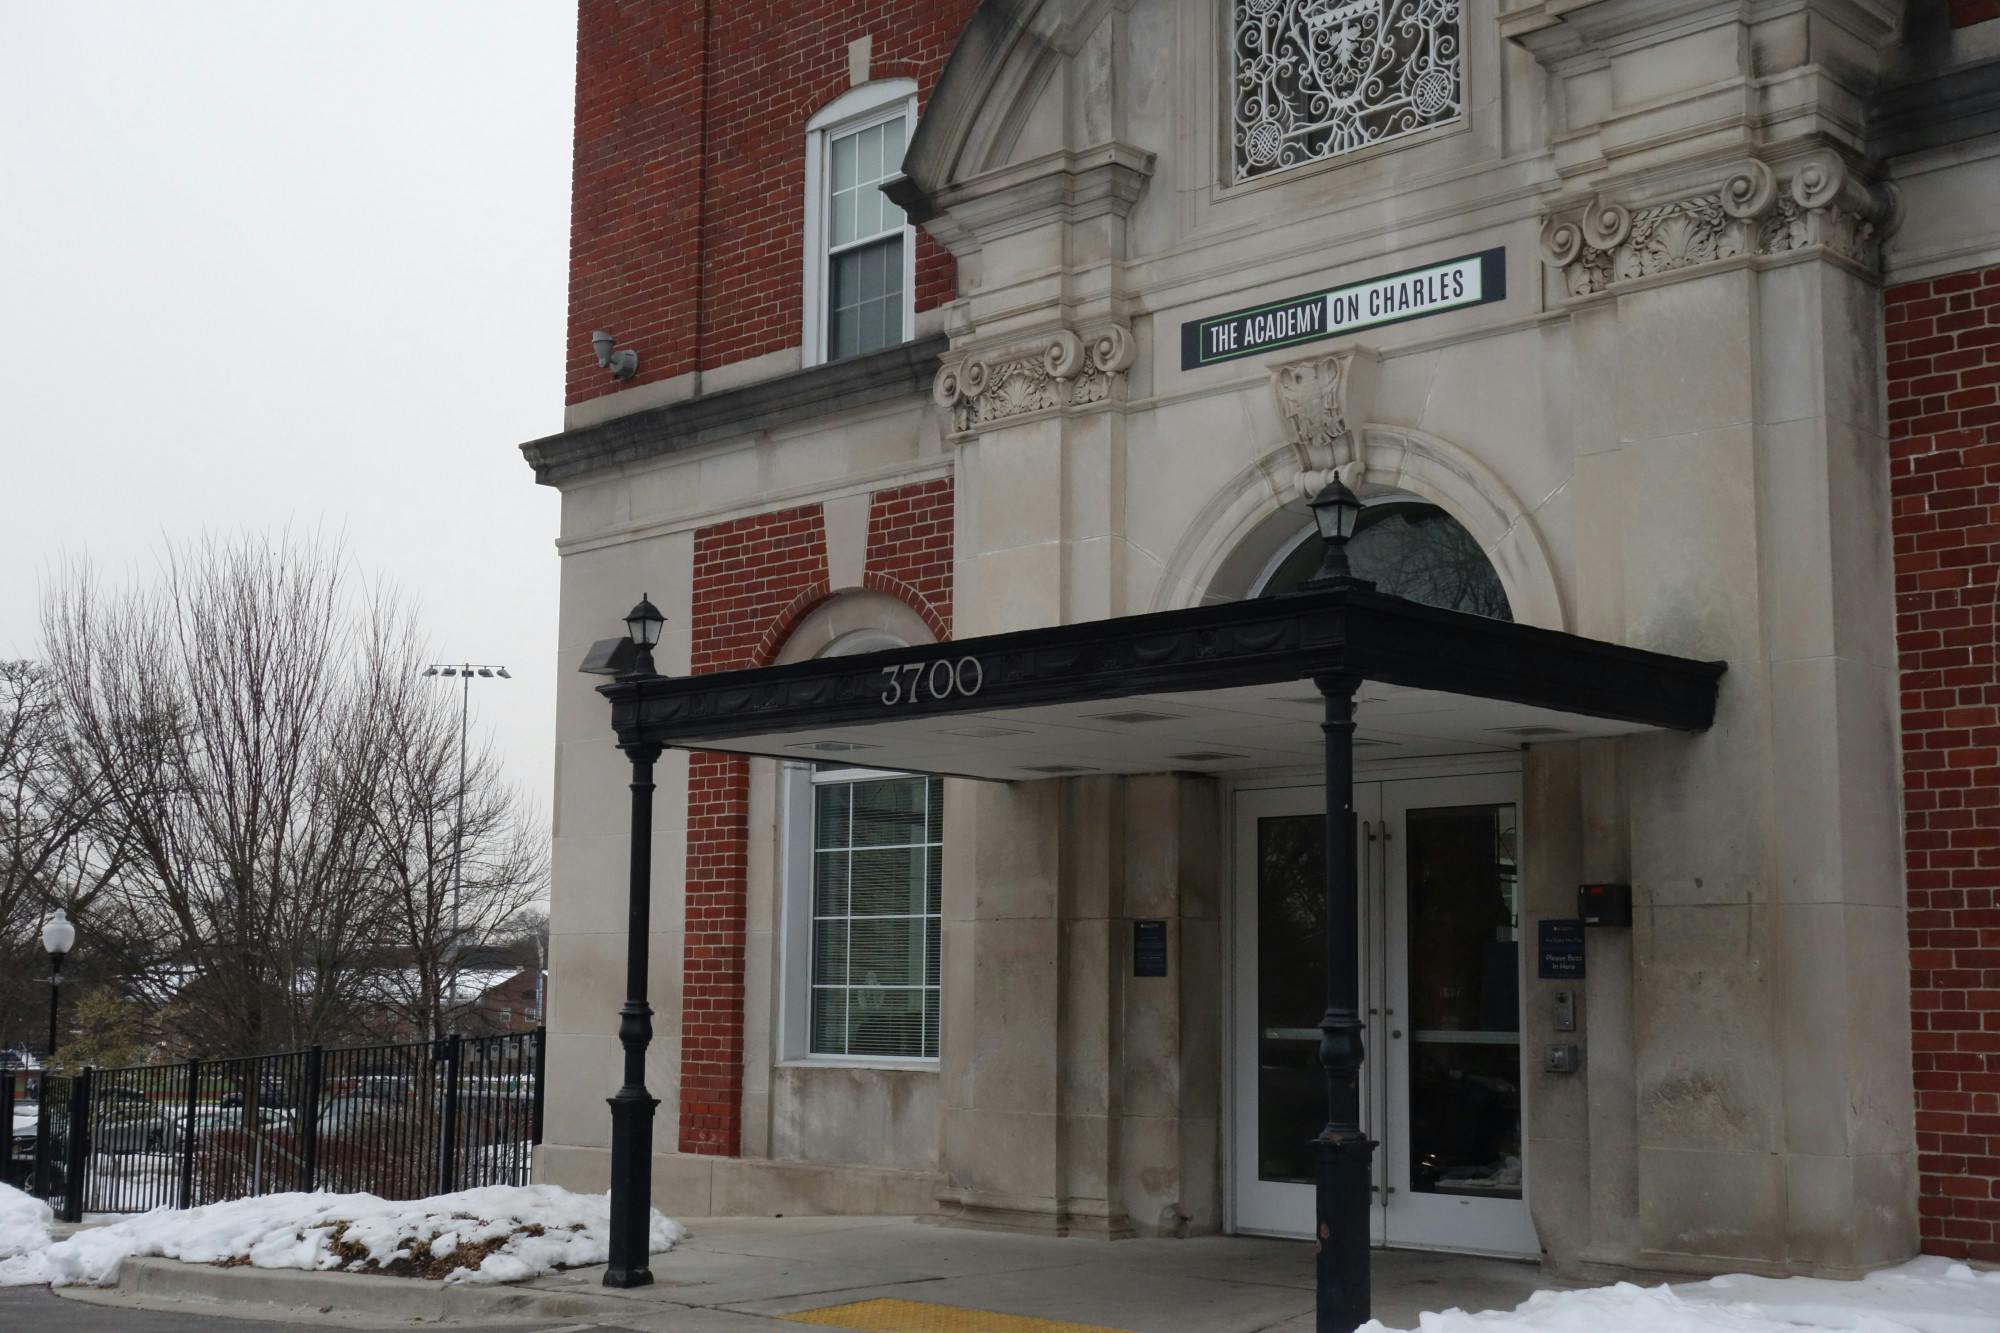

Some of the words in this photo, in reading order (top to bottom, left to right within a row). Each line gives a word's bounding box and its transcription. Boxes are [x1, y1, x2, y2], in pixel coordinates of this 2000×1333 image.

[1210, 321, 1238, 353] THE
[1244, 302, 1322, 346] ACADEMY
[1333, 293, 1359, 325] ON
[1369, 268, 1464, 317] CHARLES
[881, 655, 983, 705] 3700
